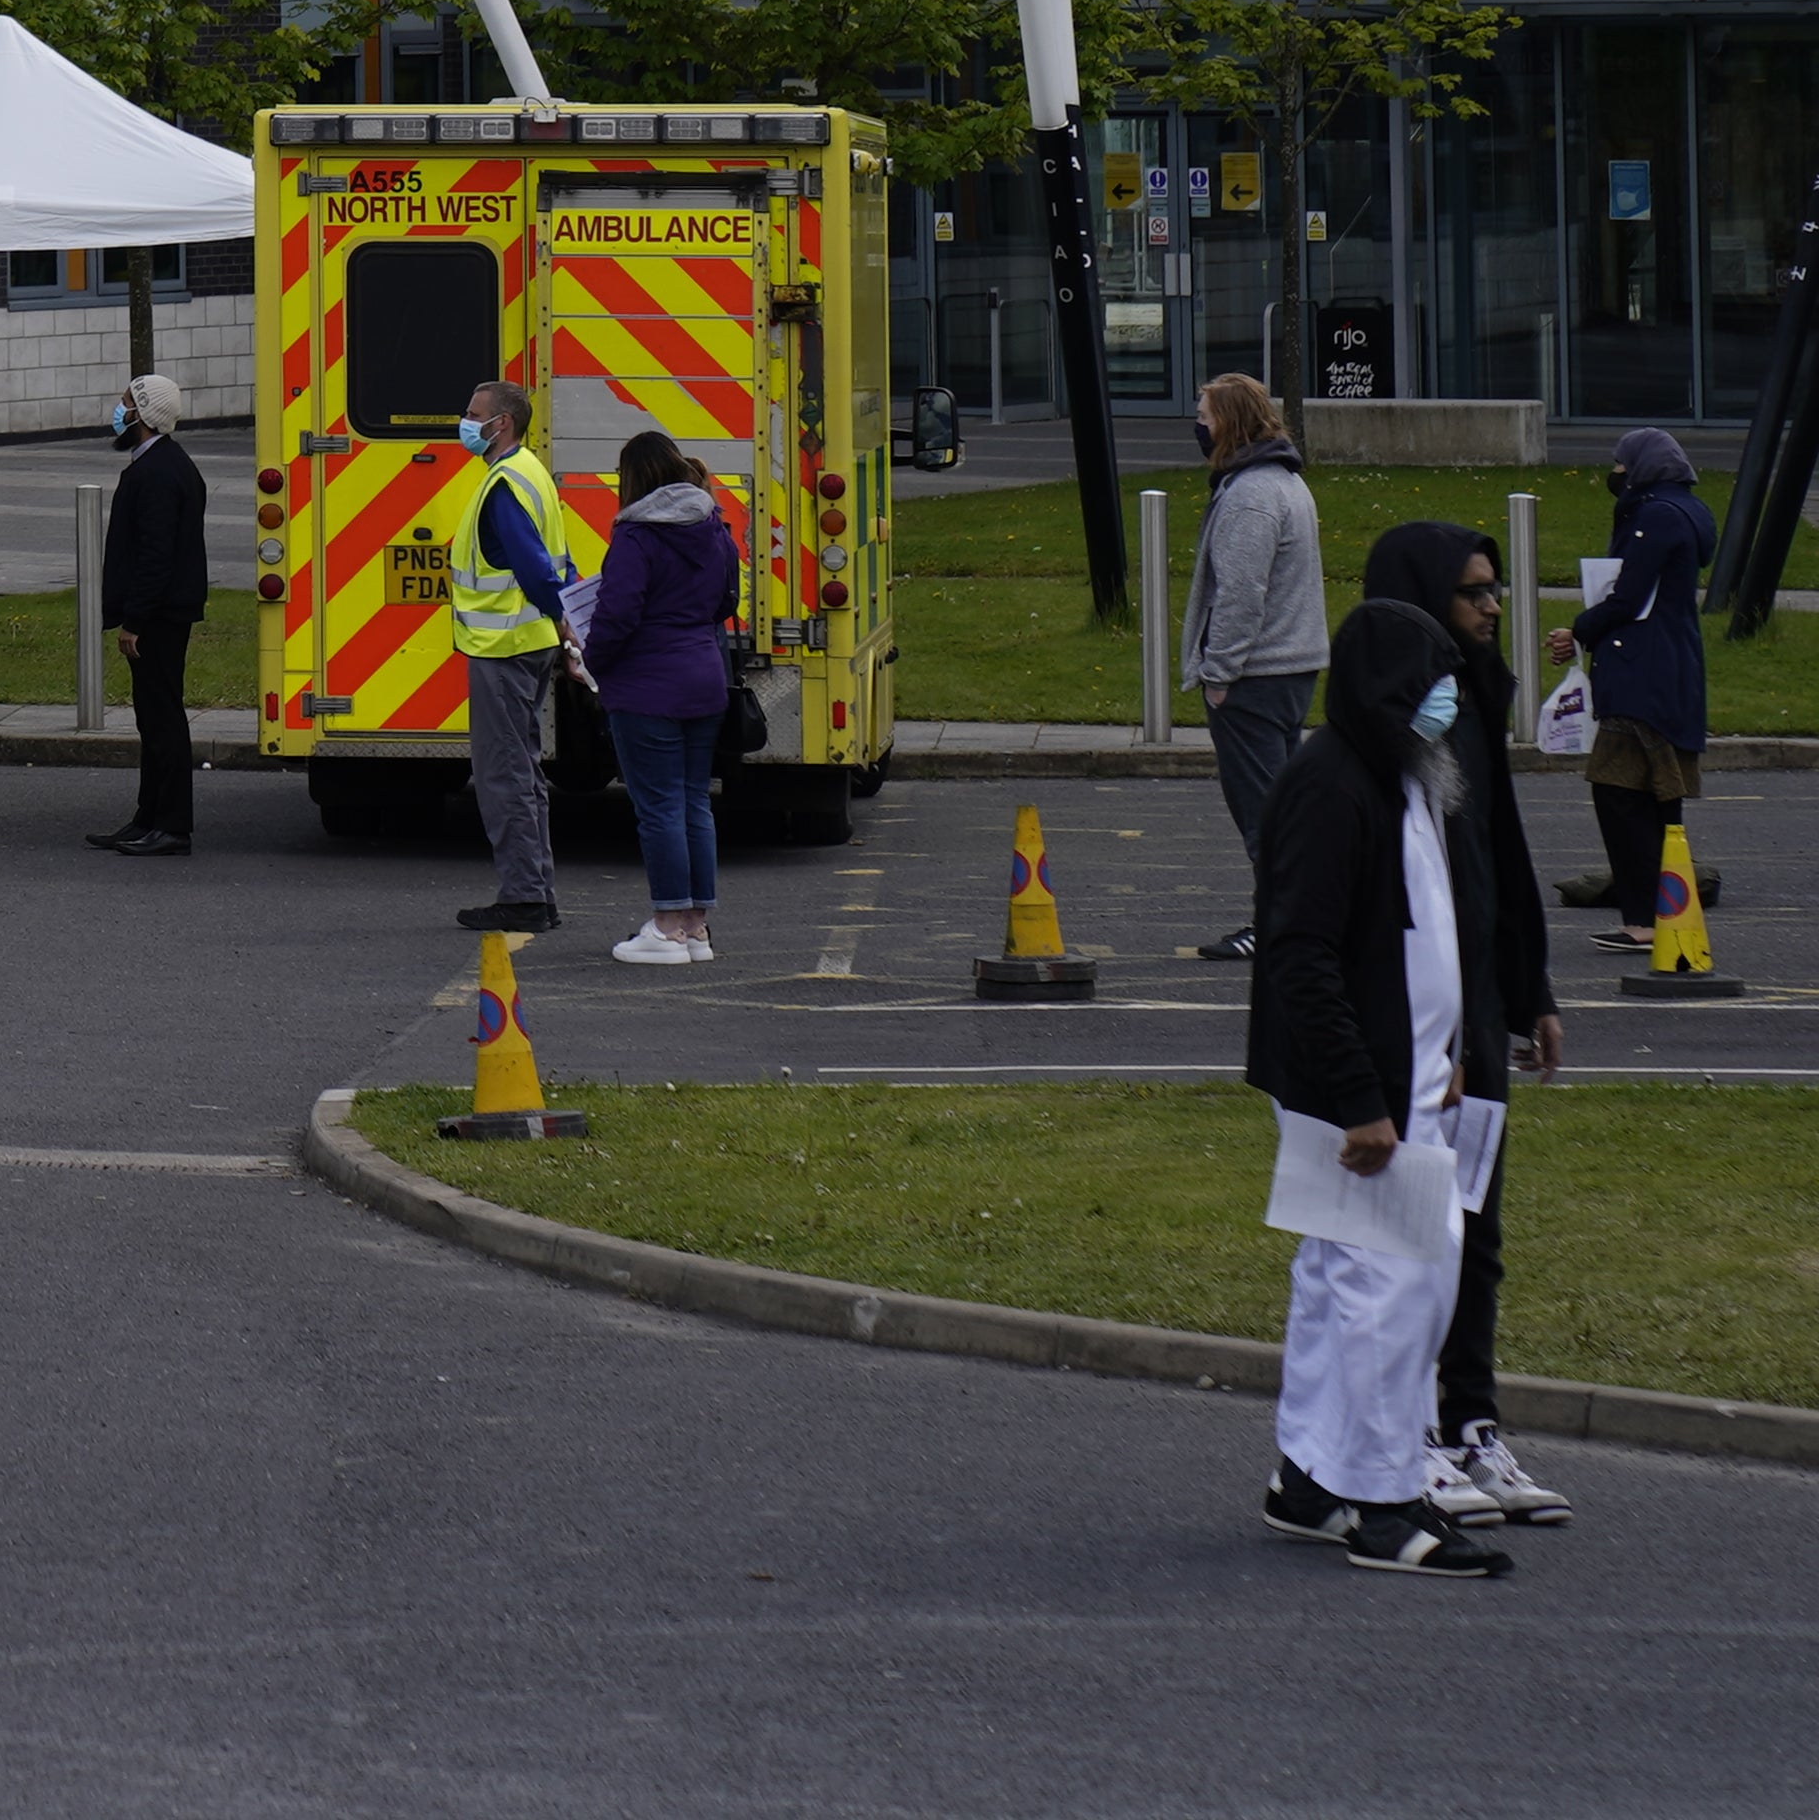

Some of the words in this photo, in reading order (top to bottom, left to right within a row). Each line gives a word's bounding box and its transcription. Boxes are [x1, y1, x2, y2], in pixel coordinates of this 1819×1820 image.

[350, 171, 422, 193] A555
[327, 196, 425, 224] NORTH
[437, 196, 517, 223] WEST
[554, 215, 751, 243] AMBULANCE
[1043, 158, 1074, 303] CIAO
[402, 577, 449, 598] FDA
